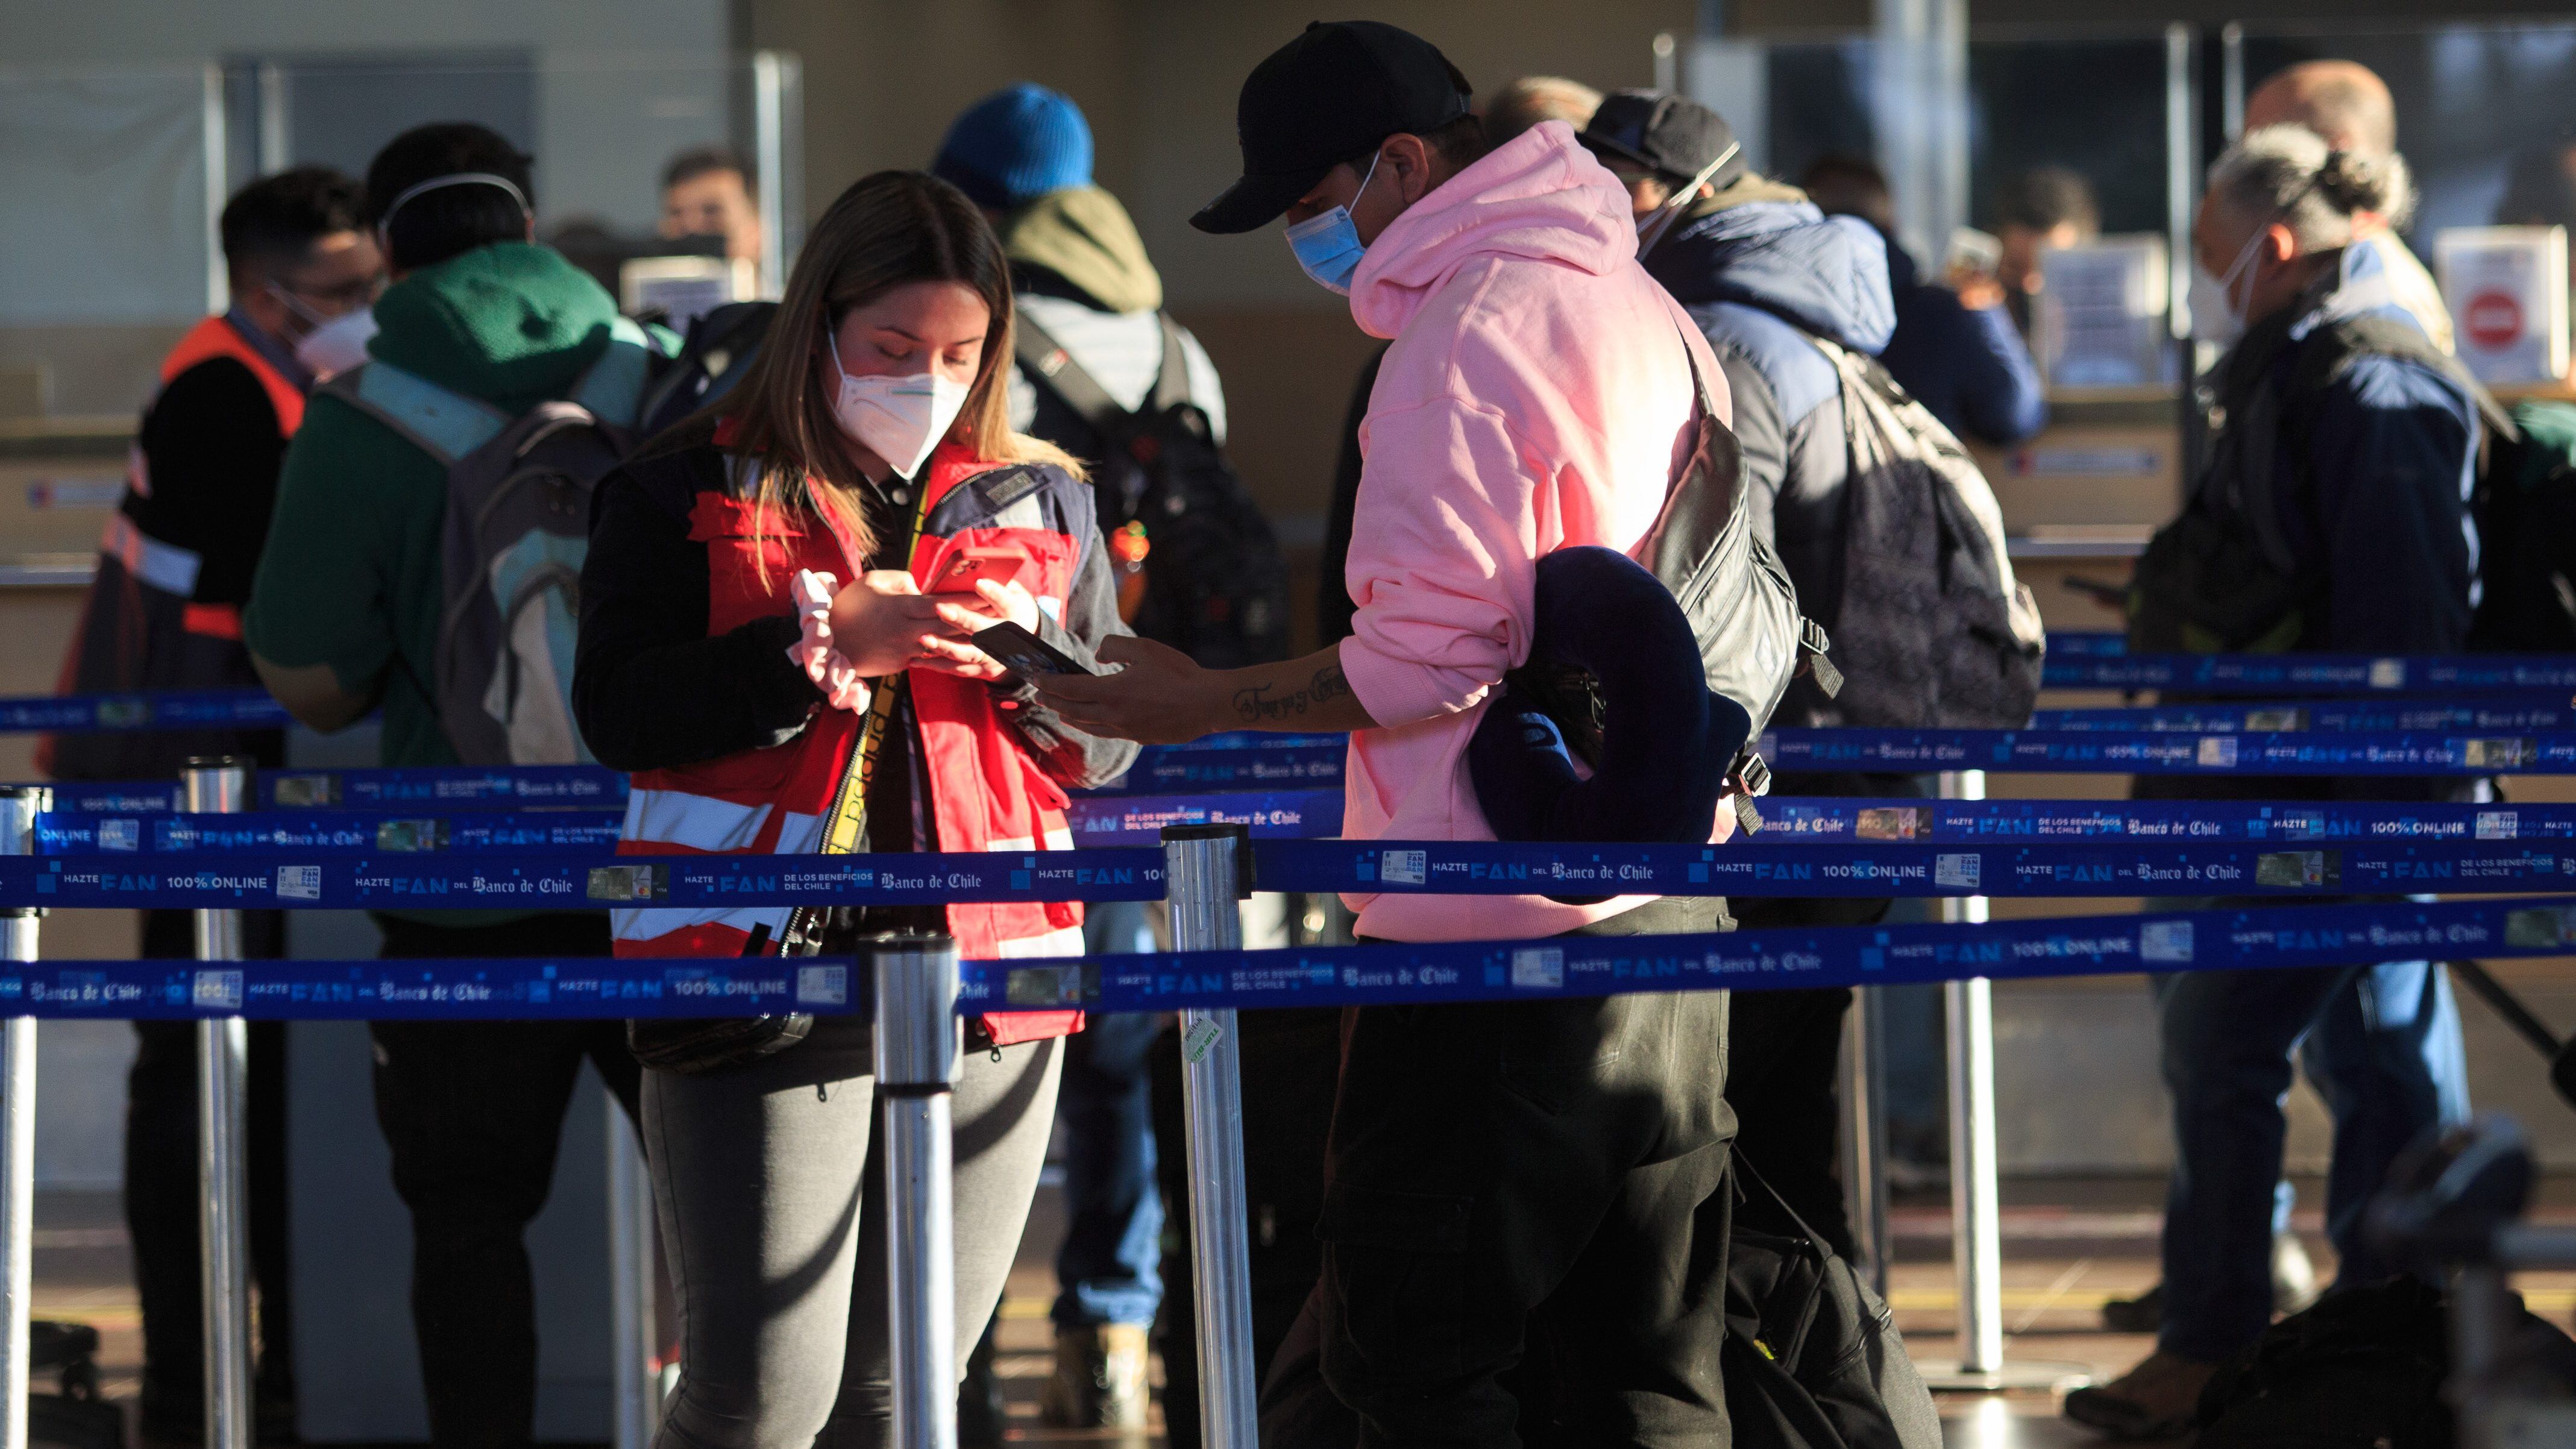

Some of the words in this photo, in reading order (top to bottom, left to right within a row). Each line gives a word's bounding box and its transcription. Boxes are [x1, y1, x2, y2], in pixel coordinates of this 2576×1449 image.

[1758, 819, 1791, 832] anco
[1946, 817, 1973, 826] HAZTE
[1978, 819, 2032, 835] FAN
[2127, 818, 2168, 835] Banco
[2172, 820, 2185, 835] de
[2188, 819, 2222, 835] Chile
[2273, 819, 2307, 829] HAZTE
[2370, 823, 2410, 834] 100%
[2413, 822, 2466, 834] ONLINE
[40, 829, 91, 841] ONLINE
[1038, 870, 1074, 879] HAZTE
[1076, 869, 1133, 885] FAN
[1432, 863, 1468, 872] HAZTE
[1471, 863, 1527, 879] FAN
[1551, 863, 1595, 879] Banco
[1600, 864, 1613, 879] de
[1619, 863, 1653, 879] Chile
[1717, 864, 1753, 872] HAZTE
[1755, 864, 1811, 880] FAN
[1823, 866, 1864, 877] 100%
[1868, 866, 1926, 877] ONLINE
[2016, 866, 2052, 875] HAZTE
[2055, 866, 2113, 882] FAN
[2137, 864, 2181, 879] Banco
[2187, 866, 2201, 879] de
[2206, 864, 2241, 879] Chile
[2394, 862, 2452, 878] FAN
[2496, 858, 2554, 867] BENEFICIOS
[64, 875, 99, 884] HAZTE
[101, 875, 157, 891] FAN
[167, 877, 208, 888] 100%
[212, 876, 267, 889] ONLINE
[356, 878, 391, 887] HAZTE
[393, 878, 448, 894] FAN
[472, 876, 515, 893] Banco
[520, 879, 533, 893] de
[539, 878, 573, 893] Chile
[685, 876, 714, 884] HAZTE
[720, 876, 776, 893] FAN
[818, 873, 873, 881] BENEFICIOS
[881, 872, 925, 890] Banco
[929, 875, 943, 888] de
[948, 872, 982, 888] Chile
[600, 981, 662, 999] FAN
[674, 981, 720, 996] 100%
[724, 980, 787, 996] ONLINE
[1158, 975, 1223, 994] FAN
[291, 985, 353, 1003] FAN
